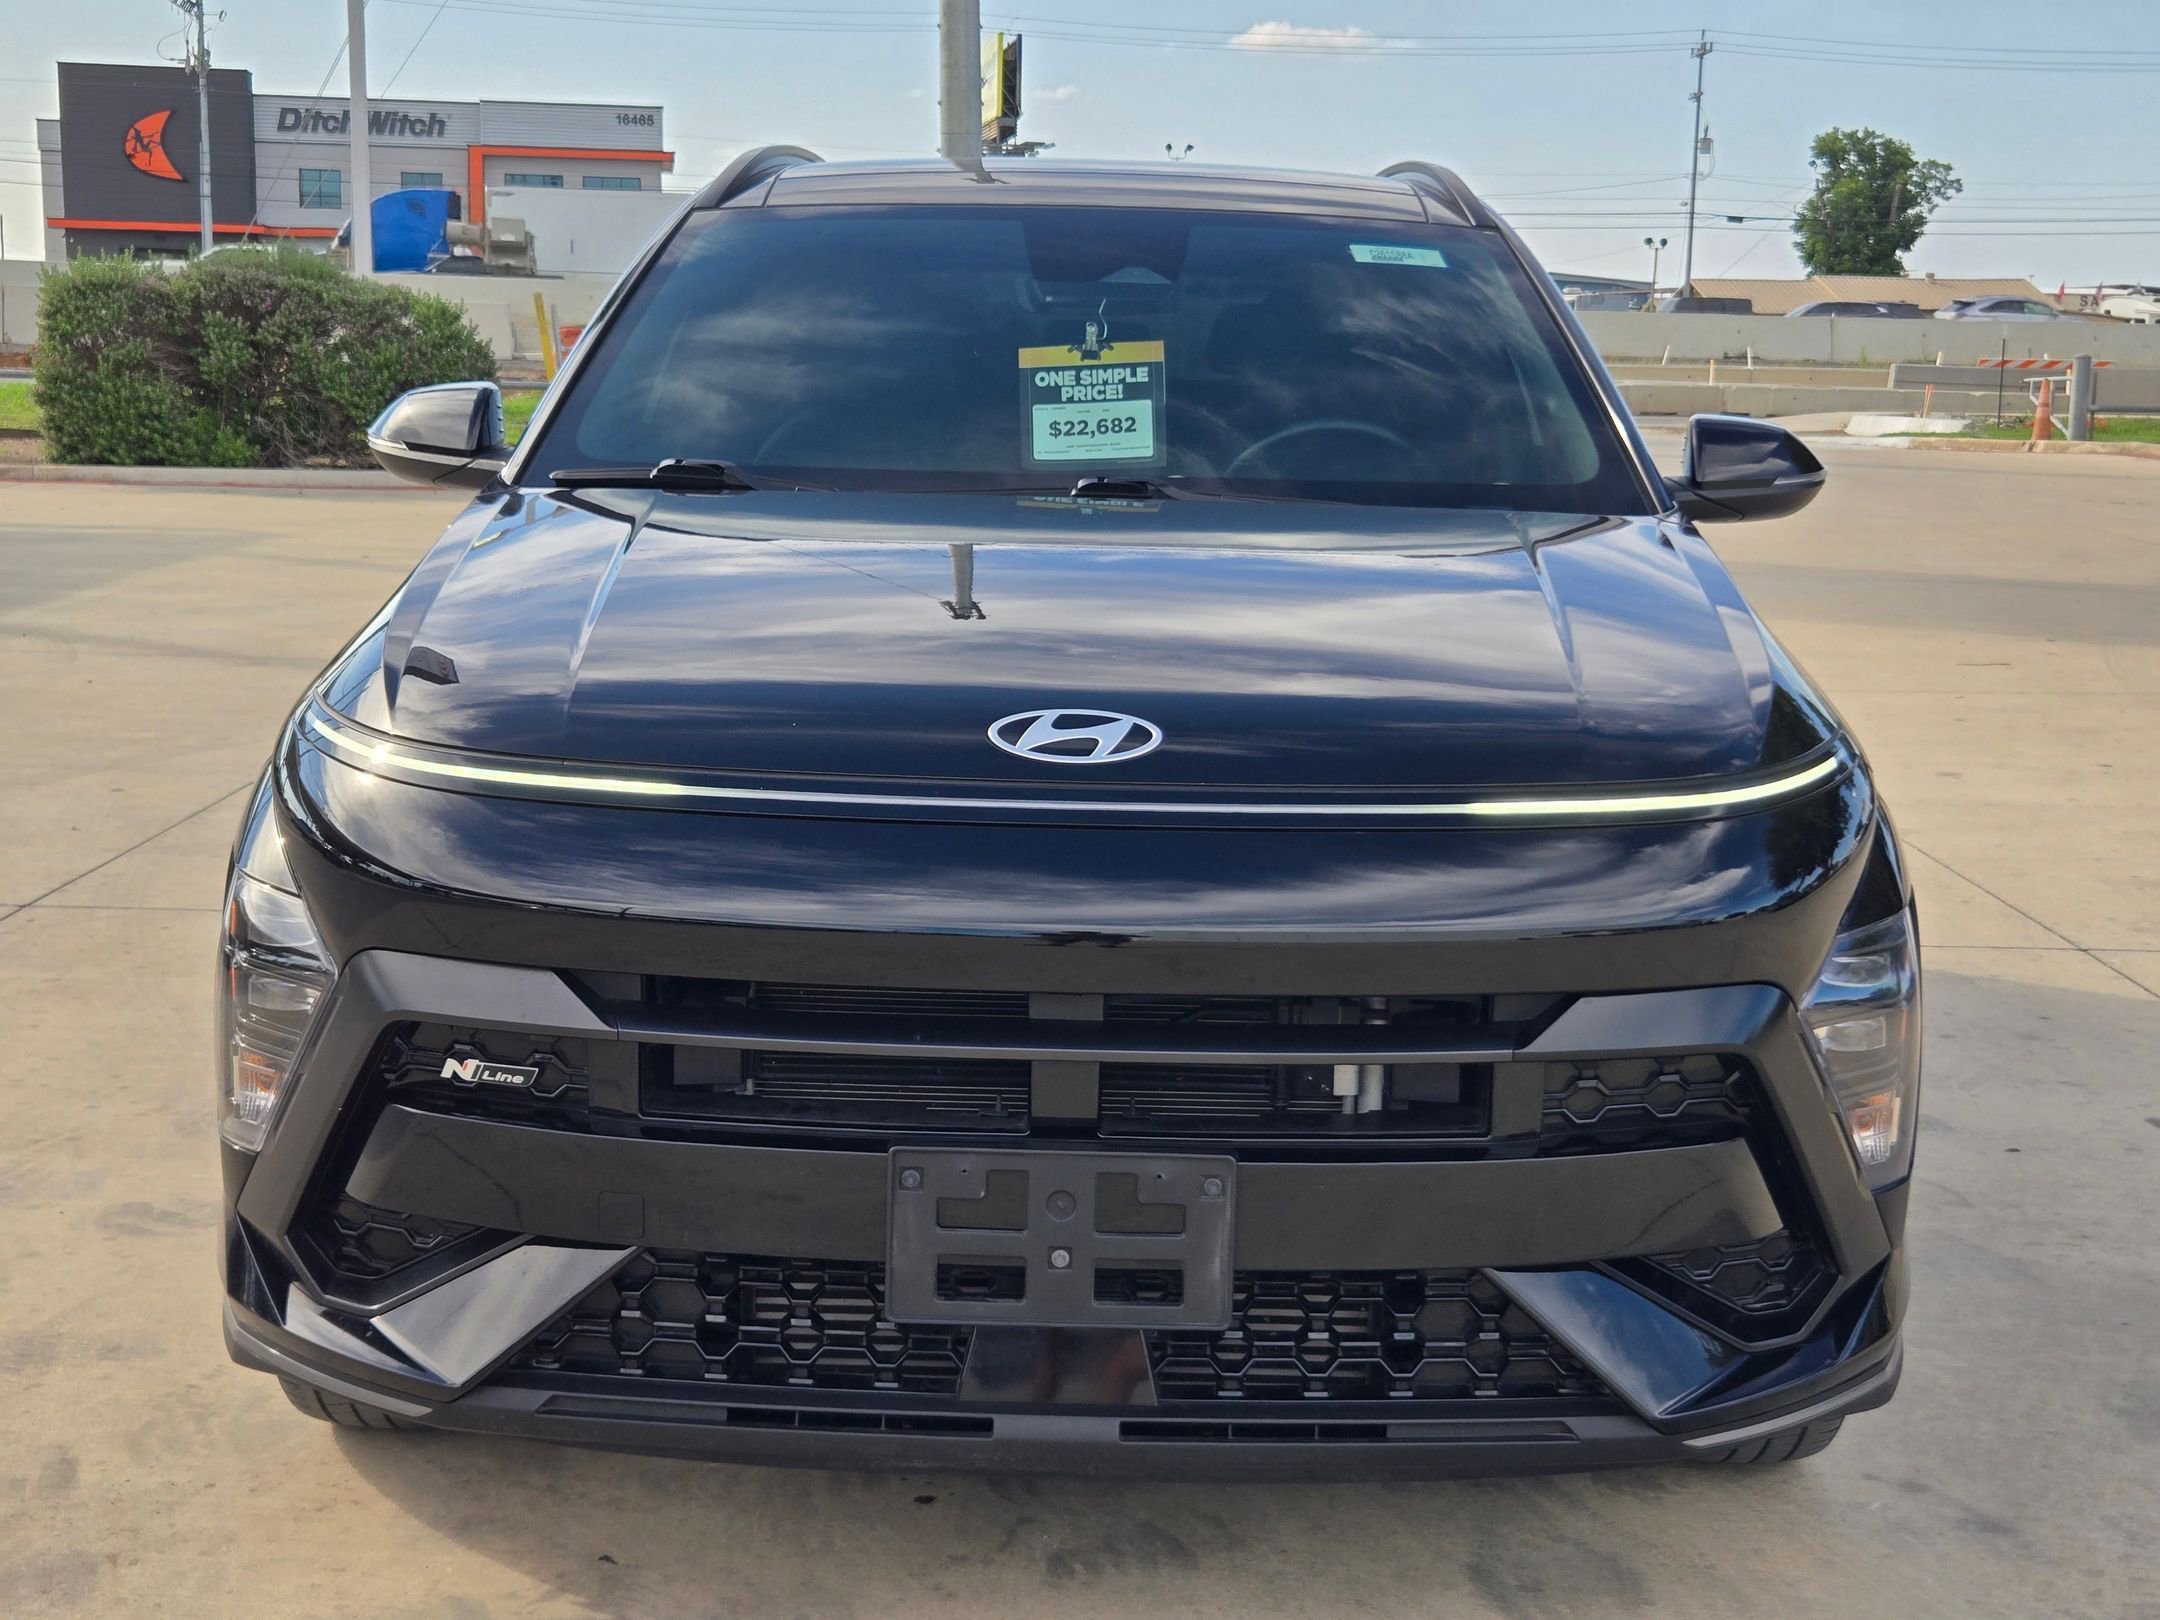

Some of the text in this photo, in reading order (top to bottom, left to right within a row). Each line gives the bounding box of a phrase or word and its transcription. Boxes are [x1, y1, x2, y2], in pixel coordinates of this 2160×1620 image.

[367, 110, 447, 137] Witch
[615, 113, 655, 127] 16465
[1034, 366, 1149, 387] ONE SIMPLE
[1061, 384, 1124, 402] PRICE!
[1048, 416, 1137, 439] $22,682
[440, 1058, 524, 1084] N Line
